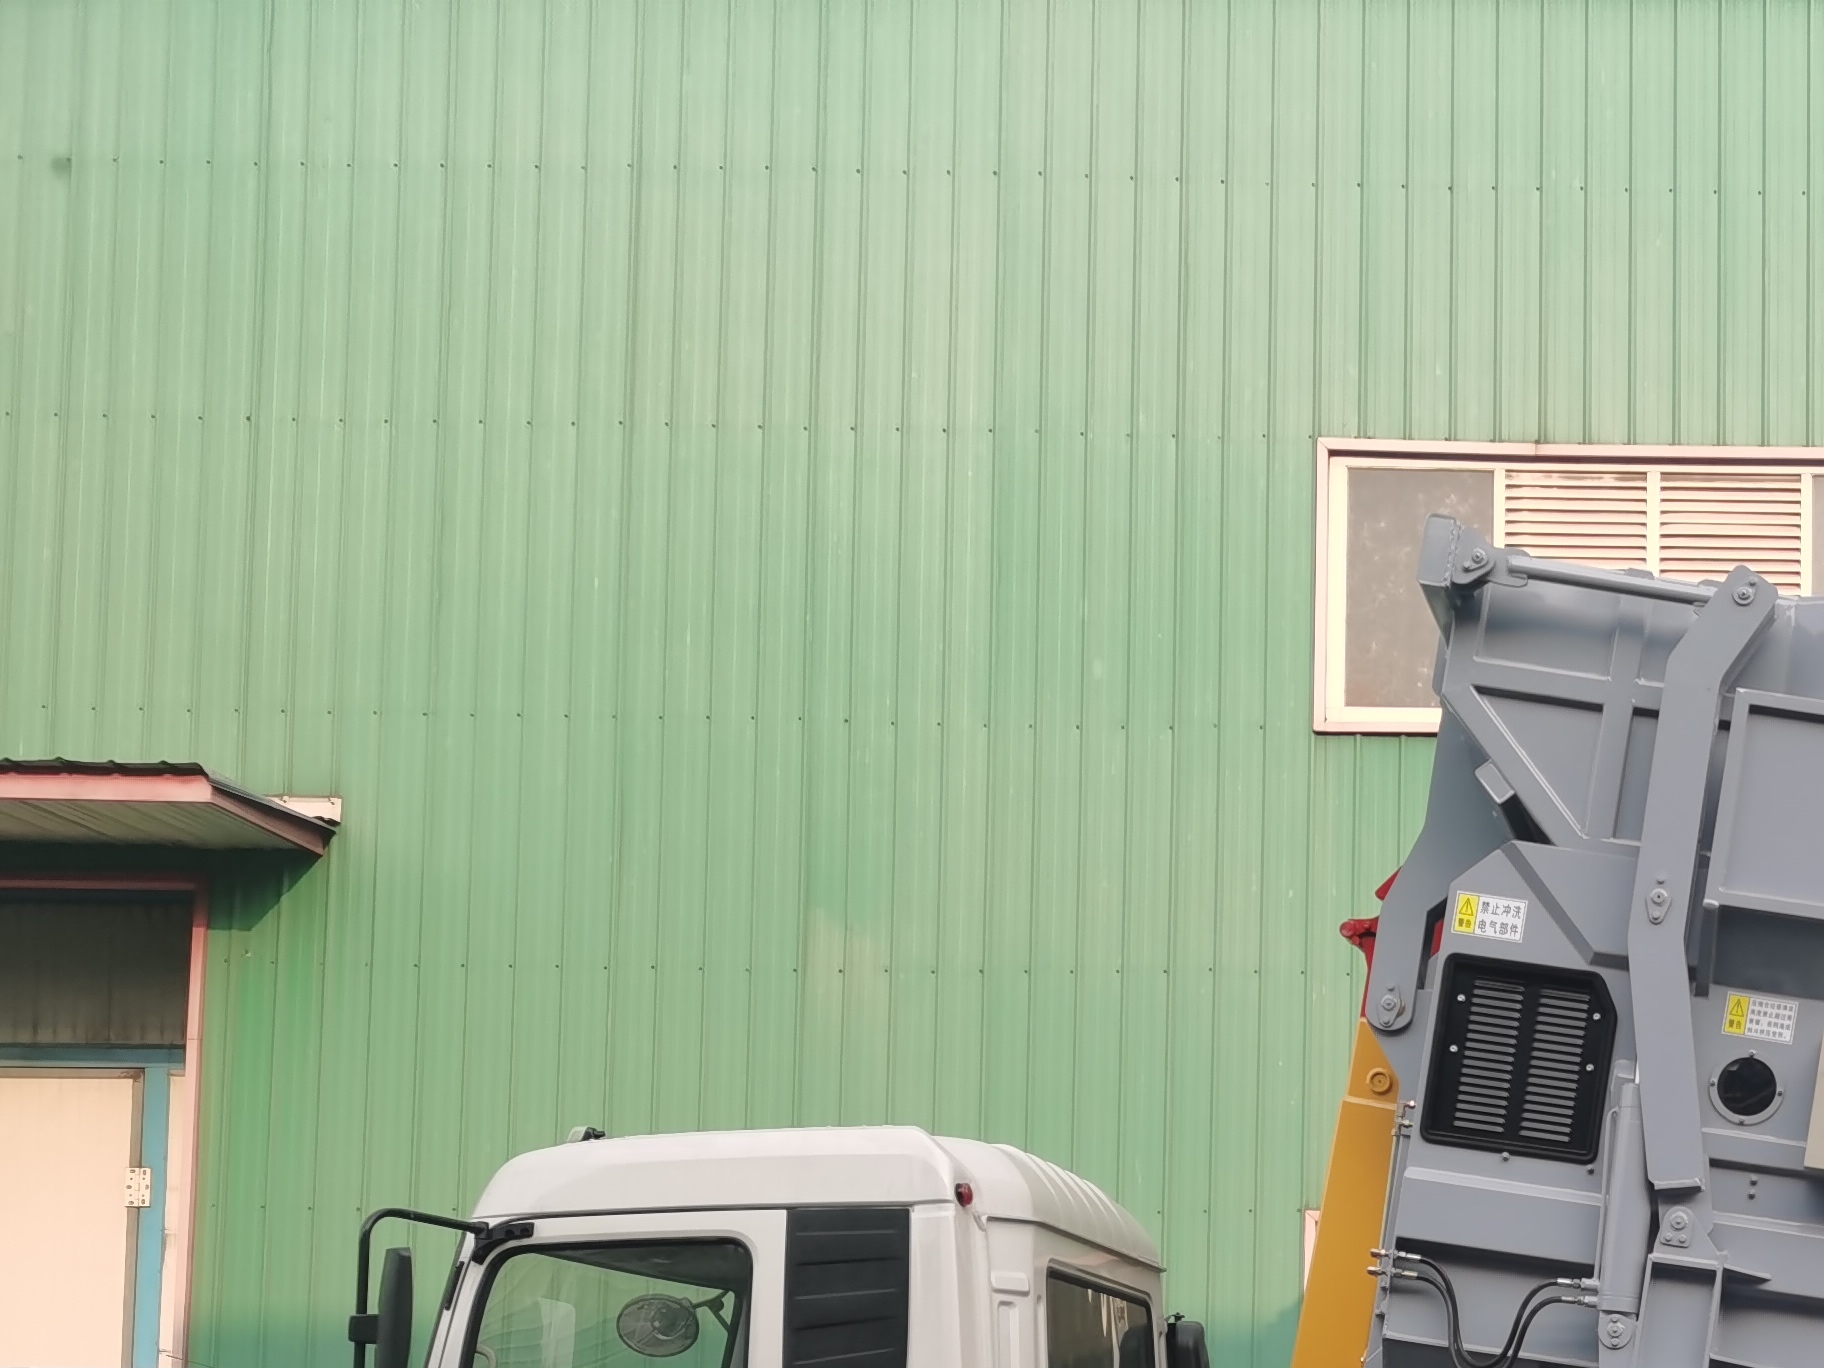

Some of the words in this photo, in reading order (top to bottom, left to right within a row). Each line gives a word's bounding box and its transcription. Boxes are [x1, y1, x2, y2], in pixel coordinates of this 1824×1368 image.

[1480, 900, 1522, 919] 禁止冲洗
[1477, 919, 1519, 938] 电气部件
